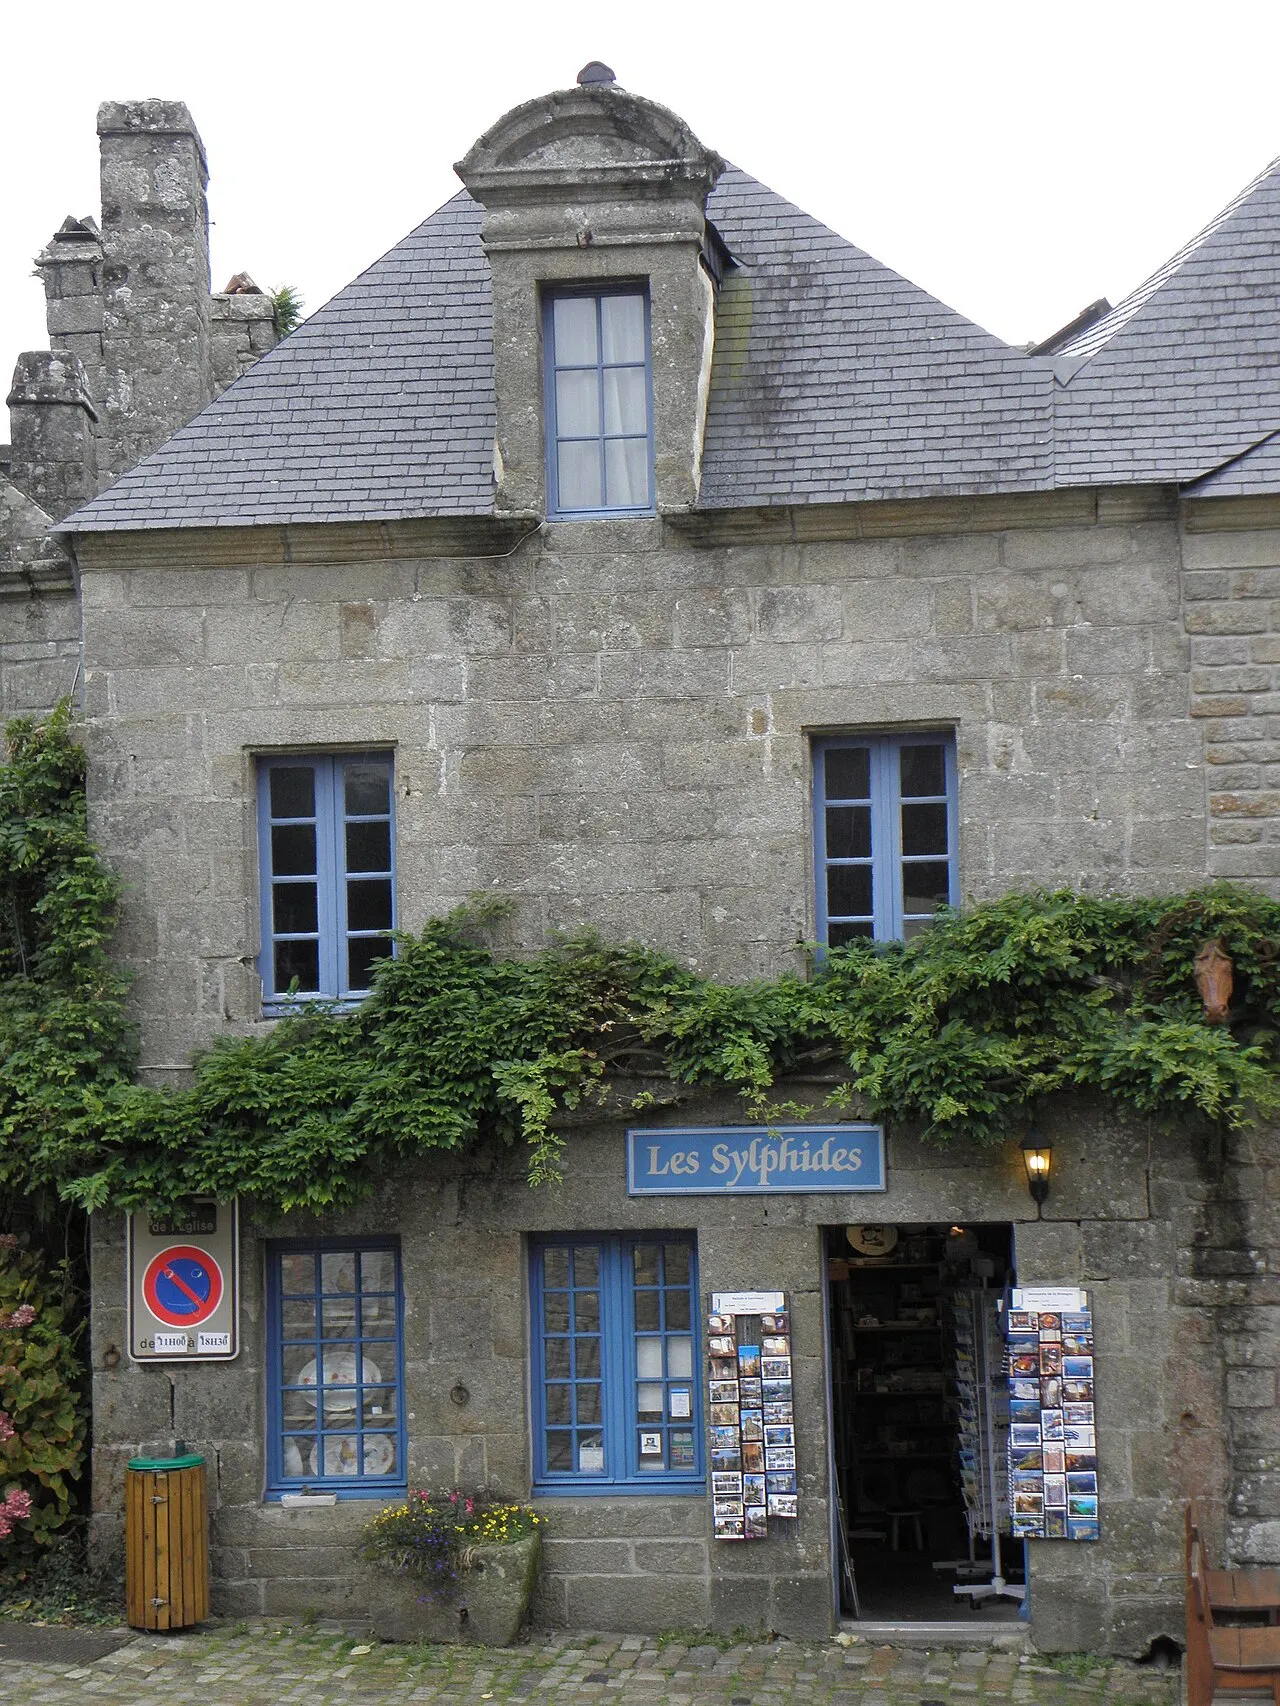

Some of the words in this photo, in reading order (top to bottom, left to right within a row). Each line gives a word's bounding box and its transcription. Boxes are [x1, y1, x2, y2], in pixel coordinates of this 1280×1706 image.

[647, 1145, 700, 1175] Les
[710, 1137, 862, 1186] Sylphides
[152, 1221, 167, 1232] de
[171, 1220, 214, 1233] lglise
[140, 1338, 155, 1348] de
[159, 1338, 186, 1346] 11H00
[188, 1337, 195, 1348] à
[201, 1337, 228, 1346] 18H30
